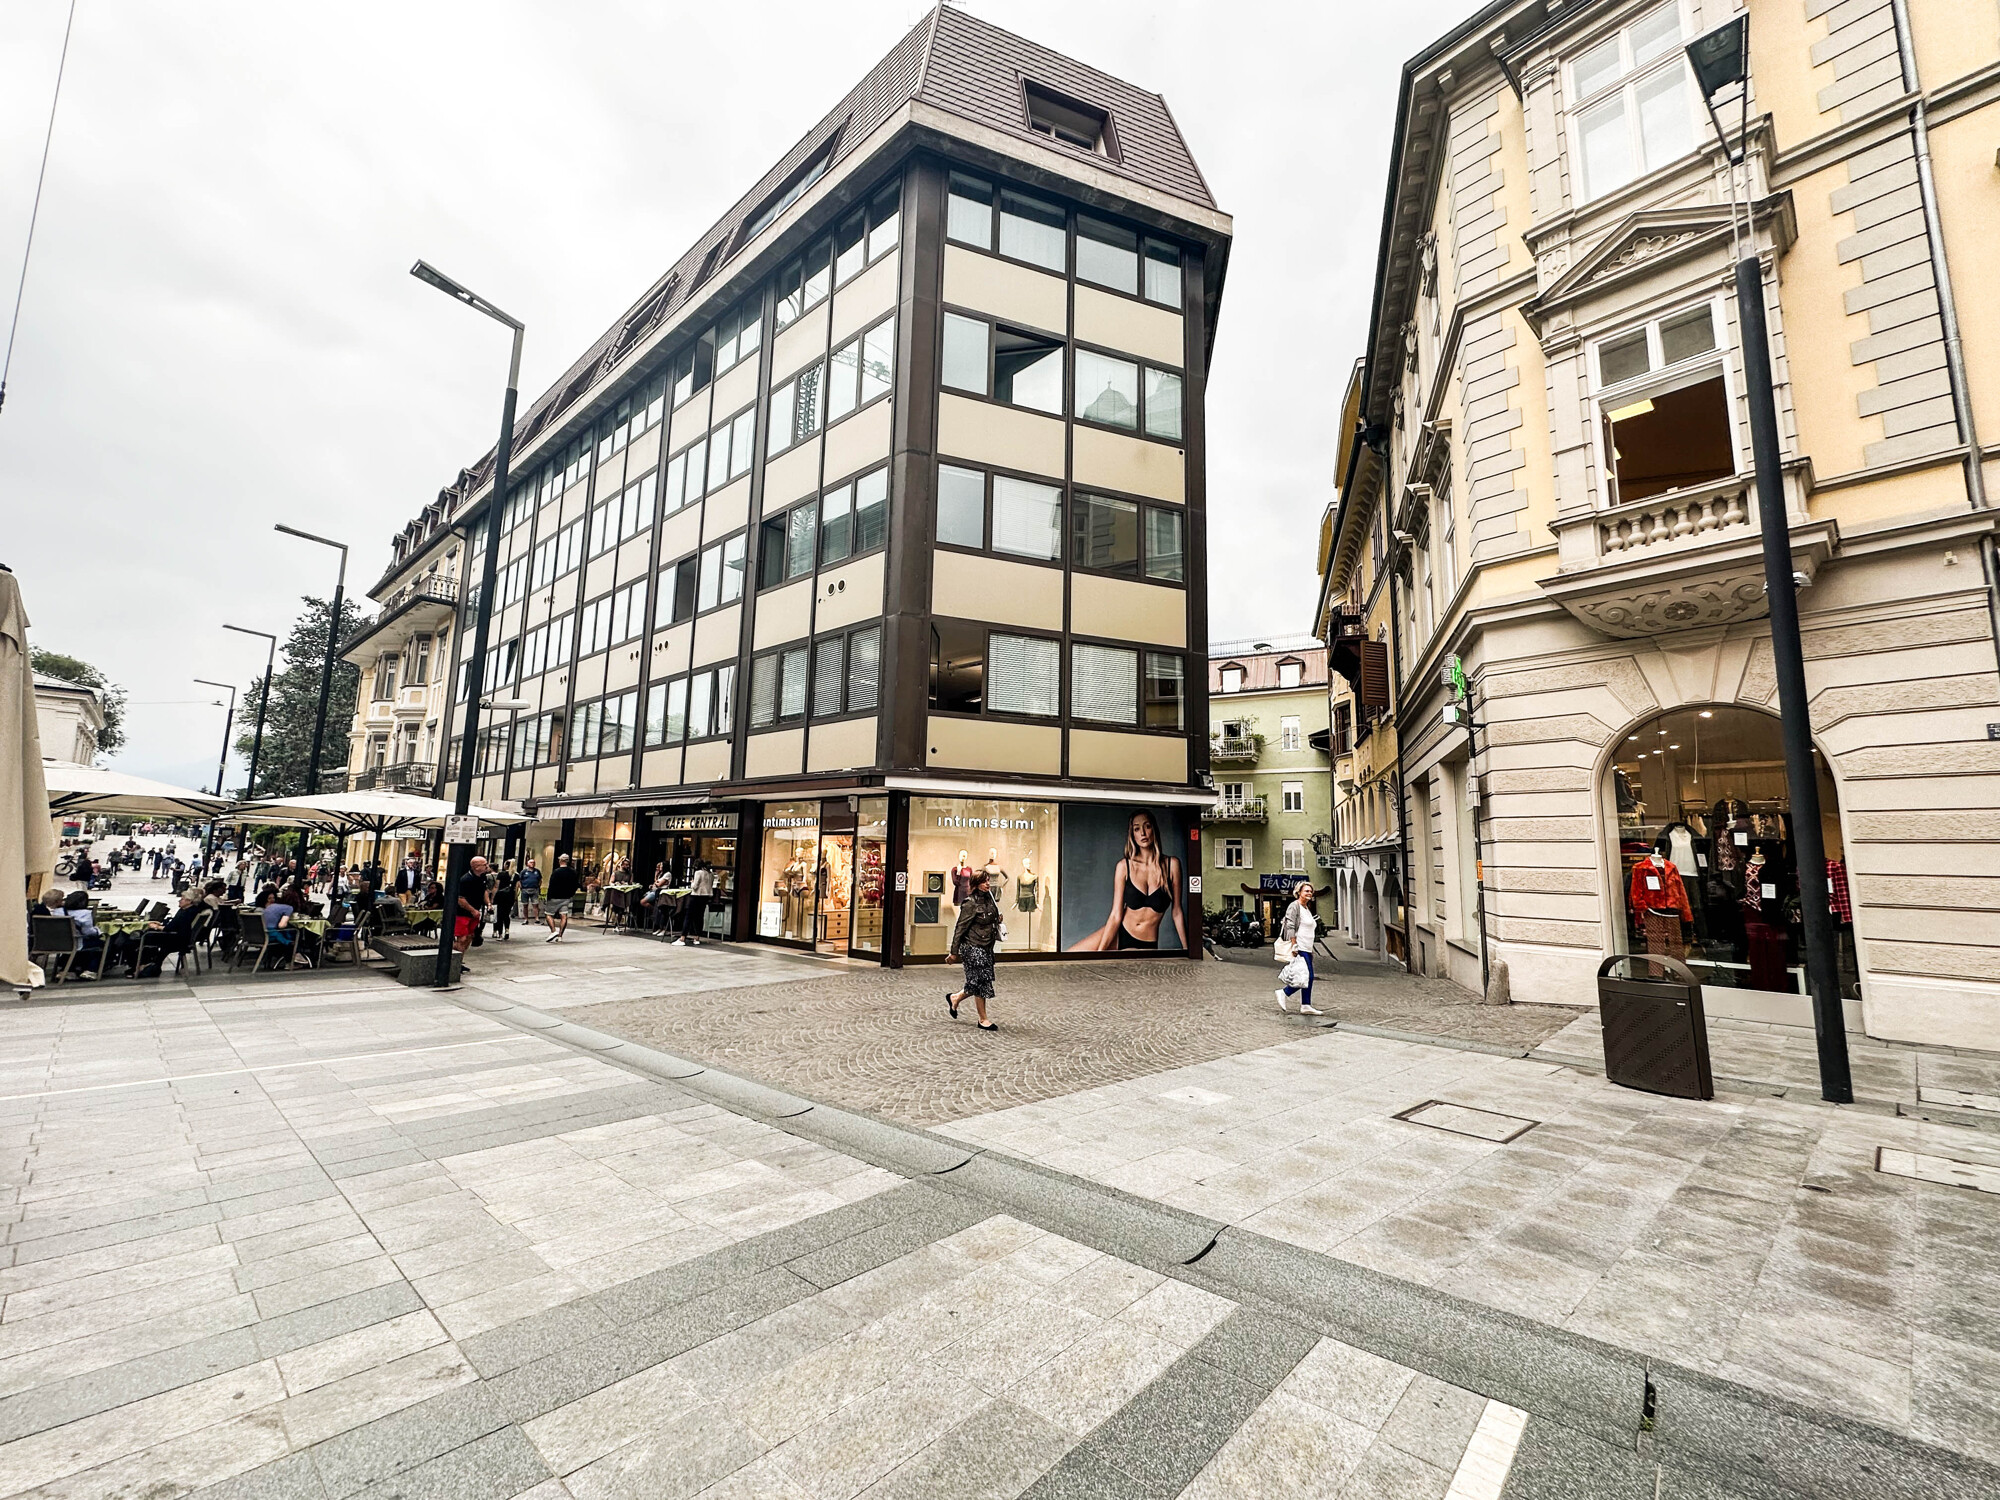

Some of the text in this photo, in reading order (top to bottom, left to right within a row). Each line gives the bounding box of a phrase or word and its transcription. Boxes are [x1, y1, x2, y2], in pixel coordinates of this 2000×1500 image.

[690, 815, 729, 829] CENTRAL
[763, 816, 818, 828] intimissimi
[937, 815, 1035, 830] intimissimi
[1262, 877, 1280, 889] TEA
